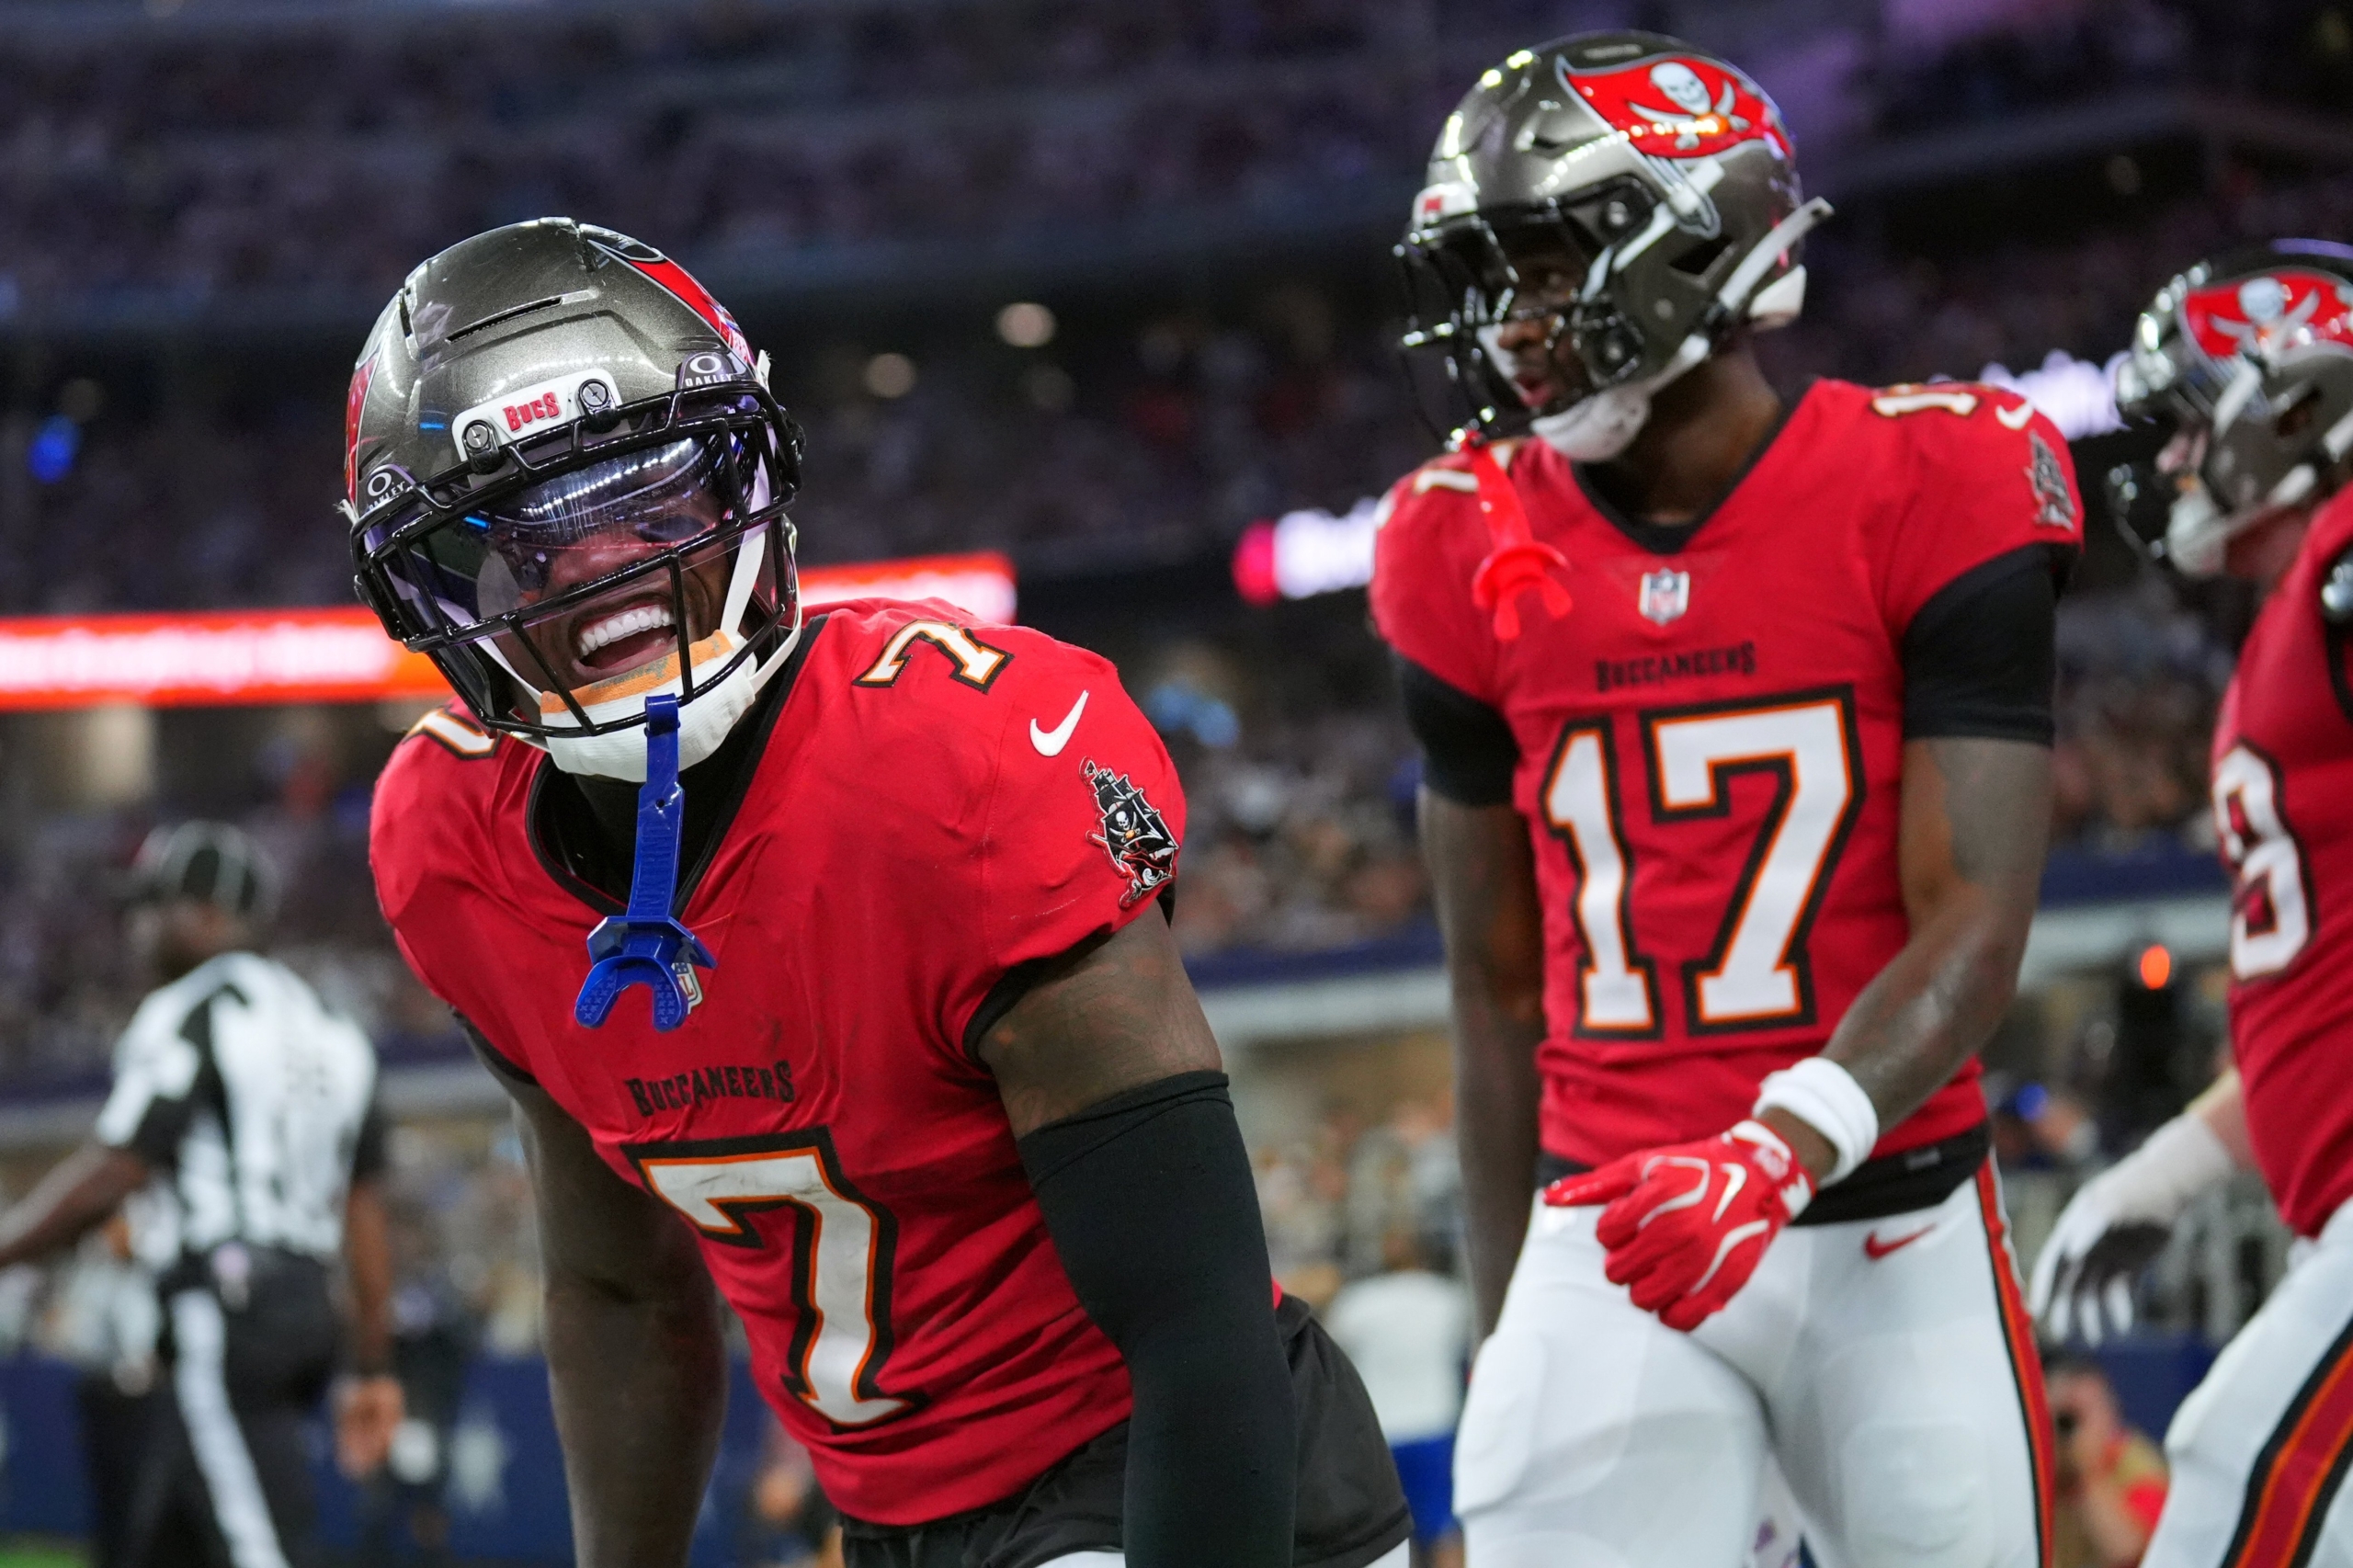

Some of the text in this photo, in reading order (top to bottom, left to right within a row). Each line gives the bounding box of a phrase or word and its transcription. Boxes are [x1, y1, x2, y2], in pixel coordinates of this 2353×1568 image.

[684, 373, 733, 388] OAKLEY
[1596, 641, 1756, 693] BUCCANEERS
[1539, 683, 1867, 1041] 17
[623, 1060, 796, 1118] BUCCANEERS
[620, 1124, 931, 1436] 7
